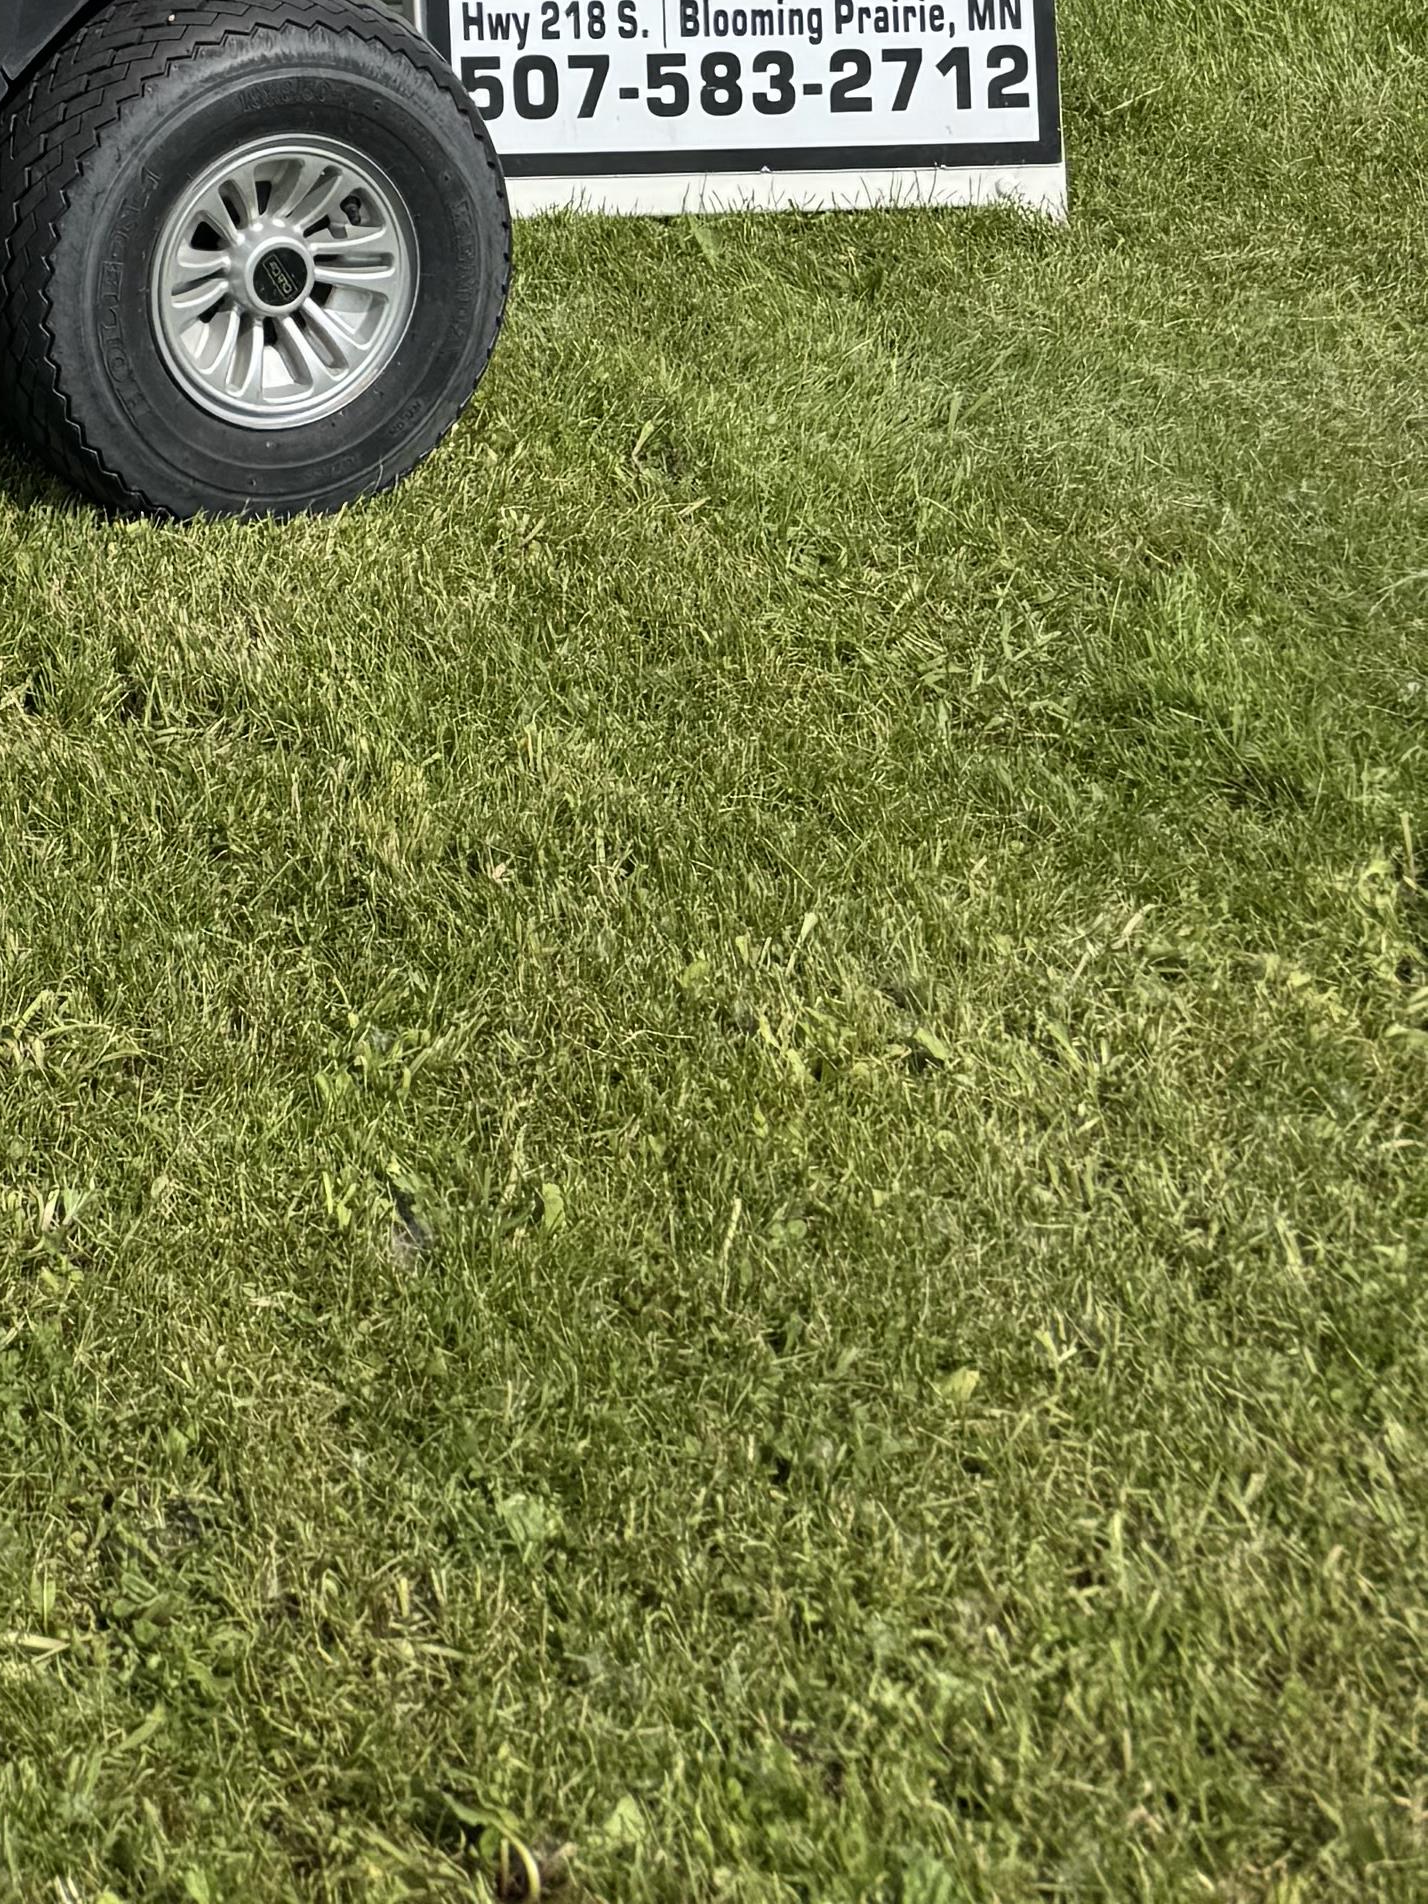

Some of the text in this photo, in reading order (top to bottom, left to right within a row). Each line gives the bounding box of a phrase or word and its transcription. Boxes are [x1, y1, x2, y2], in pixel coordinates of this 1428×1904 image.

[461, 1, 530, 50] Hwy
[541, 0, 607, 41] 218
[618, 0, 650, 39] S.
[460, 45, 1030, 122] 507-583-2712
